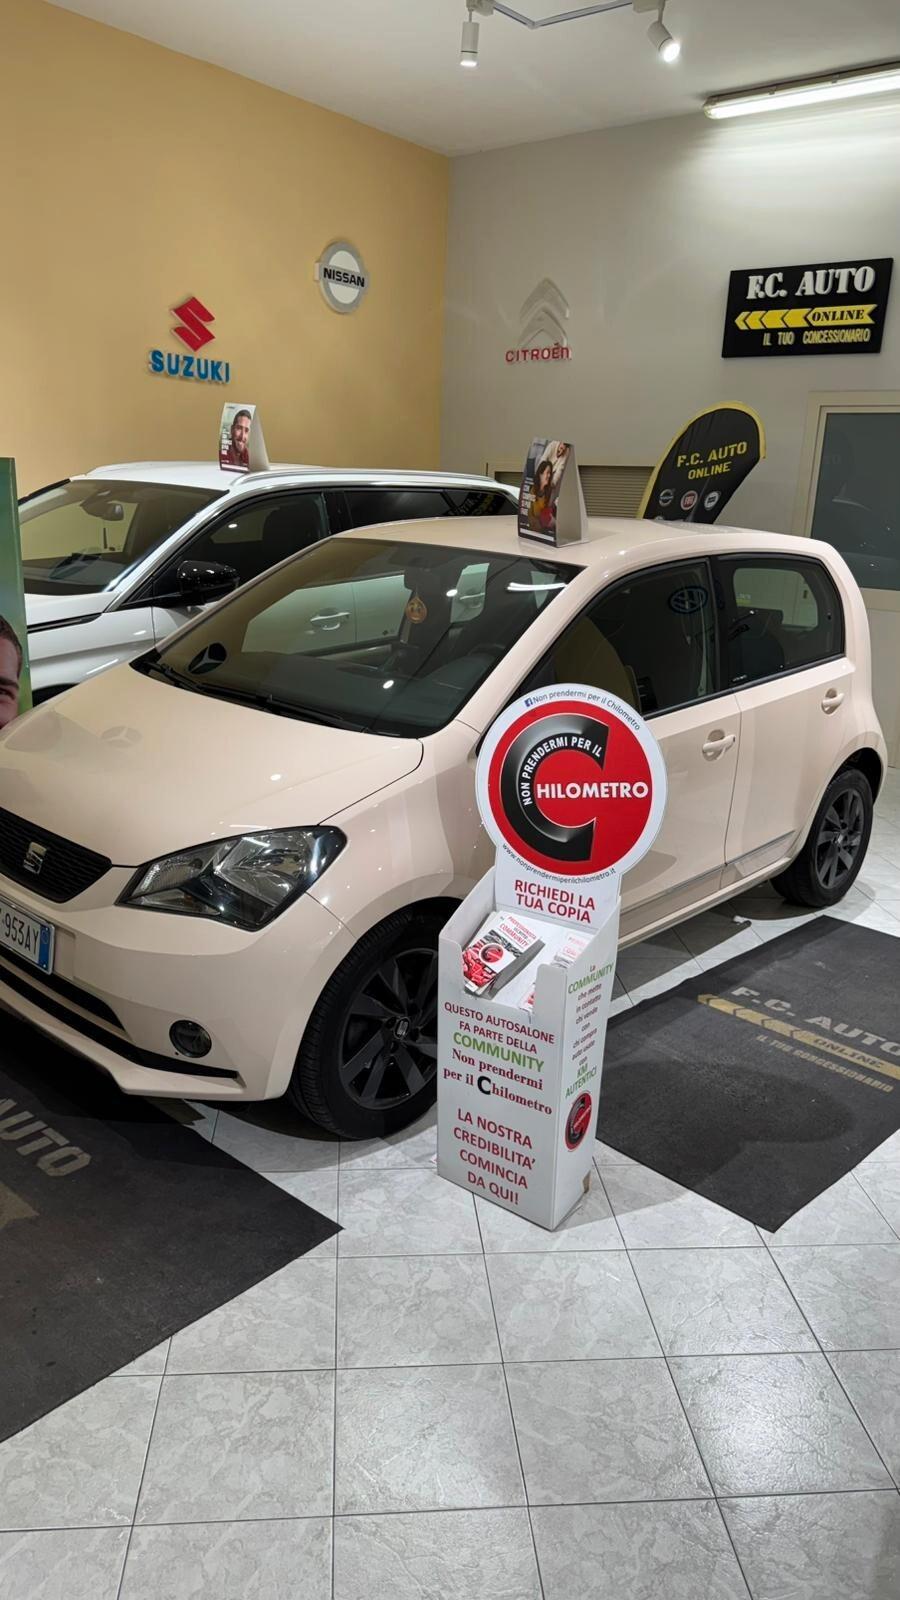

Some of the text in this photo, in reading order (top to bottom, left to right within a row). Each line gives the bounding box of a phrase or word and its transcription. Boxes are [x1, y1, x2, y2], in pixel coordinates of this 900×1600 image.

[323, 267, 365, 287] NISSAN
[746, 266, 875, 299] F.C. AUTO
[812, 309, 865, 322] ONLINE
[763, 328, 871, 346] IL TUO CONCESSIONARIO
[150, 349, 230, 383] SUZUKI
[677, 441, 748, 468] F.C. AUTO
[688, 461, 732, 480] ONLINE
[533, 689, 641, 731] Non prendermi per il Chilometro
[521, 736, 603, 806] NON PRENDERMI PER IL
[514, 879, 596, 911] RICHIEDI LA
[516, 893, 592, 924] TUA COPIA
[567, 962, 614, 994] COMMUNITY
[731, 986, 797, 1017] F.C.
[444, 1001, 555, 1044] QUESTO AUTOSALONE
[459, 1021, 537, 1054] FA PARTE DELLA
[453, 1031, 544, 1073] COMMUNITY
[757, 1034, 895, 1093] IL TUO CONCESSIONARIO
[813, 1038, 886, 1069] ONLINE
[452, 1048, 544, 1091] Non prendermi
[565, 1065, 597, 1098] AUTENTICI
[577, 1063, 588, 1078] KM
[443, 1067, 553, 1115] per il Chilometro
[0, 1098, 92, 1176] UTO
[457, 1108, 533, 1149] LA NOSTRA
[459, 1148, 529, 1189] COMINCIA
[467, 1171, 519, 1205] DA QUI!
